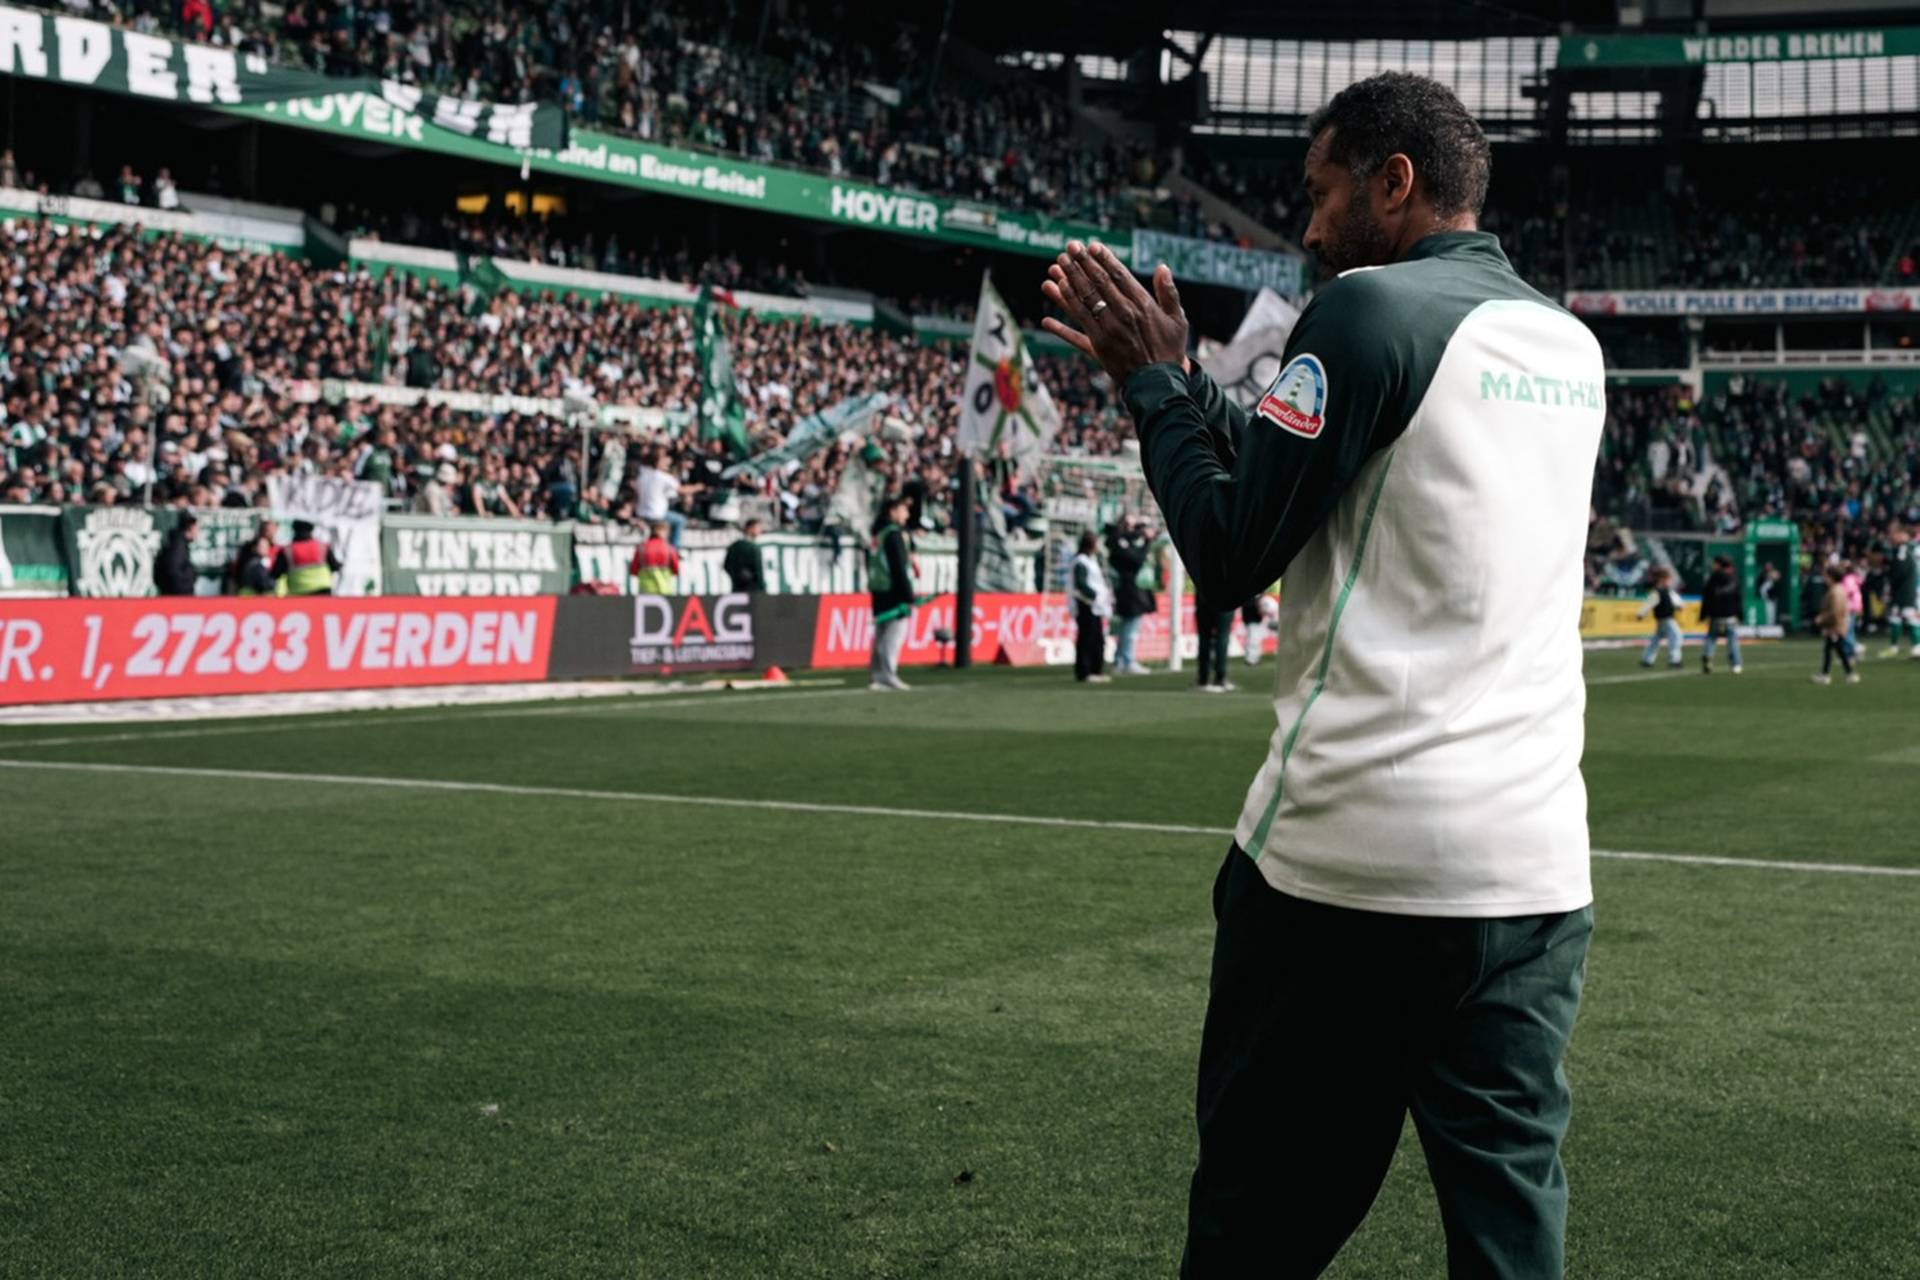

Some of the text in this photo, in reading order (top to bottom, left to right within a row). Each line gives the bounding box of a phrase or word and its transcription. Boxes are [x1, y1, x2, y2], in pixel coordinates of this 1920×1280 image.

[1683, 32, 1884, 62] WERDER BREMEN
[608, 153, 638, 175] an
[830, 185, 939, 233] HOYER
[1624, 295, 1678, 312] VOLLE
[1685, 294, 1735, 311] PULLE
[1784, 292, 1858, 309] BREMEN
[397, 529, 557, 571] L'INTESA
[634, 593, 753, 645] DAG
[0, 609, 537, 690] R. 1, 27283 VERDEN
